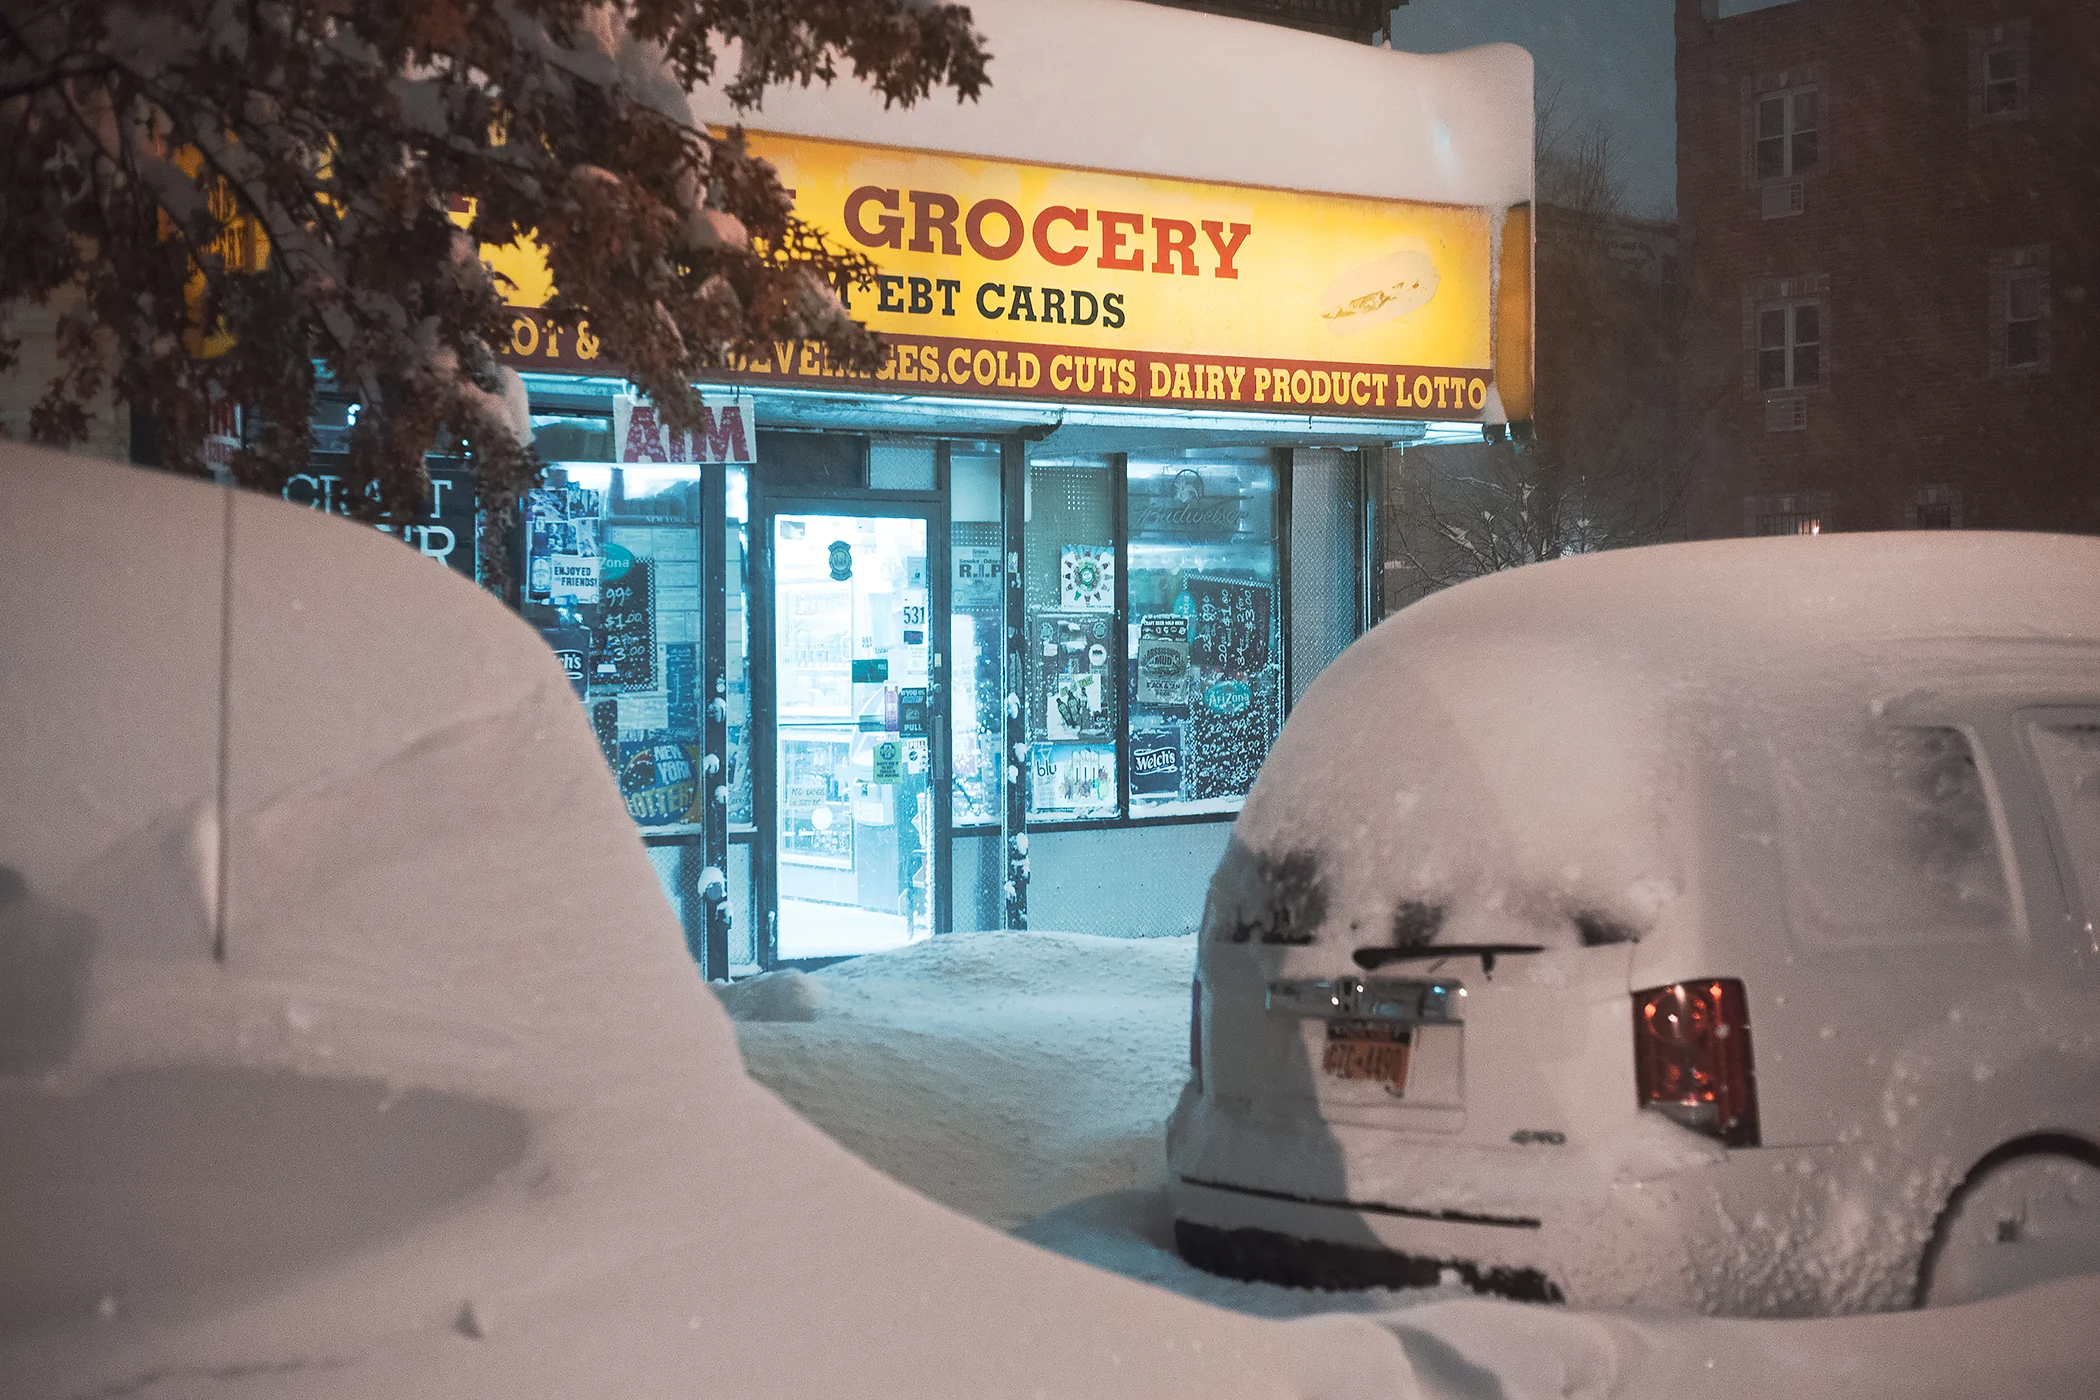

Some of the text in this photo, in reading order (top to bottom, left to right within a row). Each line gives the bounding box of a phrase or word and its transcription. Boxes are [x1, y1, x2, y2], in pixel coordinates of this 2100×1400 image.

[843, 185, 1251, 280] GROCERY
[975, 281, 1126, 329] CARDS
[1050, 353, 1137, 395] CUTS
[1150, 361, 1246, 400] DAIRY
[1254, 367, 1388, 407] PRODUCT
[1396, 374, 1488, 410] LOTTO
[554, 566, 591, 576] ENJOYED
[561, 576, 598, 587] FRIENDS!
[903, 606, 925, 624] 531
[1208, 690, 1250, 707] AriZona
[904, 723, 923, 732] PULL
[908, 740, 926, 749] PULL
[1036, 760, 1057, 777] blu
[1135, 750, 1176, 770] Welch's
[657, 760, 692, 783] YORK
